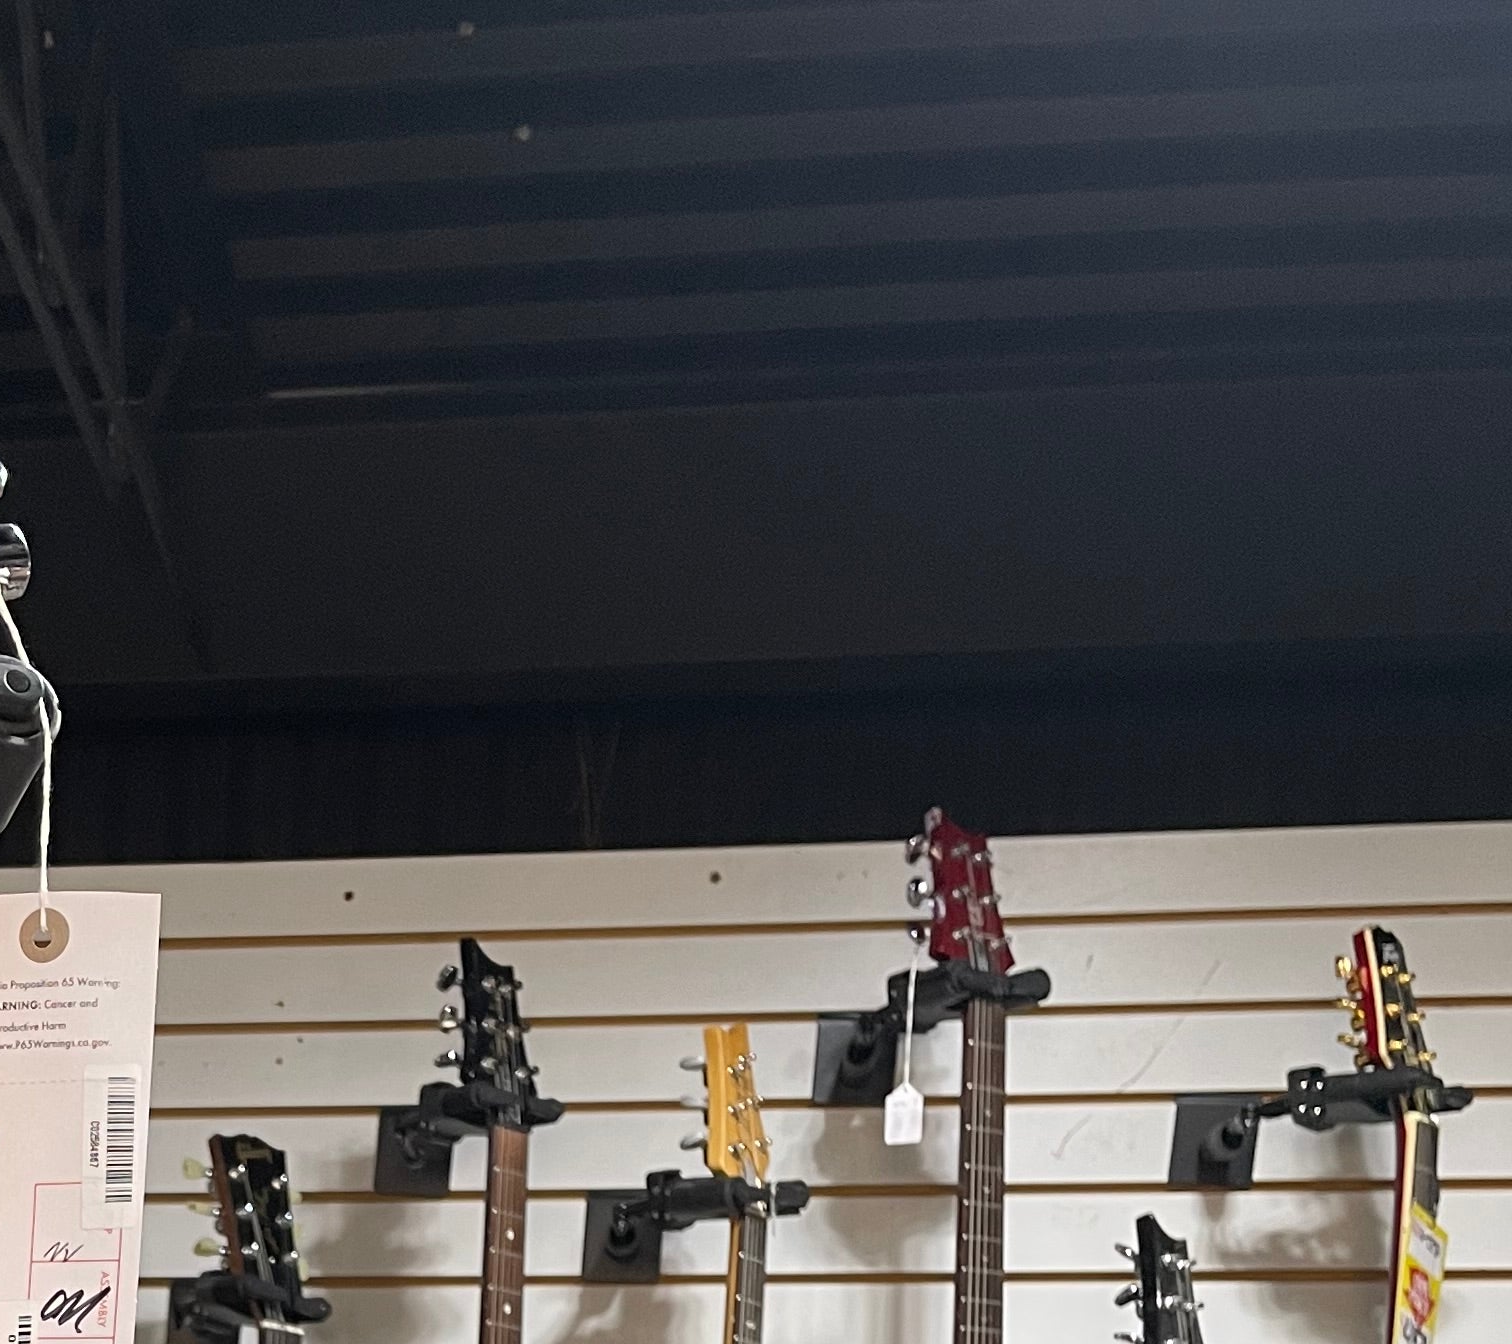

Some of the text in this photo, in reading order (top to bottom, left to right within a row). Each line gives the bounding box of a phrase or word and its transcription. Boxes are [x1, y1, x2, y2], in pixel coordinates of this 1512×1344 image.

[10, 979, 59, 991] Proposition
[61, 977, 74, 987] 65
[44, 999, 76, 1010] Cancer
[79, 997, 99, 1008] and
[41, 1021, 67, 1031] Harm
[96, 1270, 111, 1328] ASMBLY
